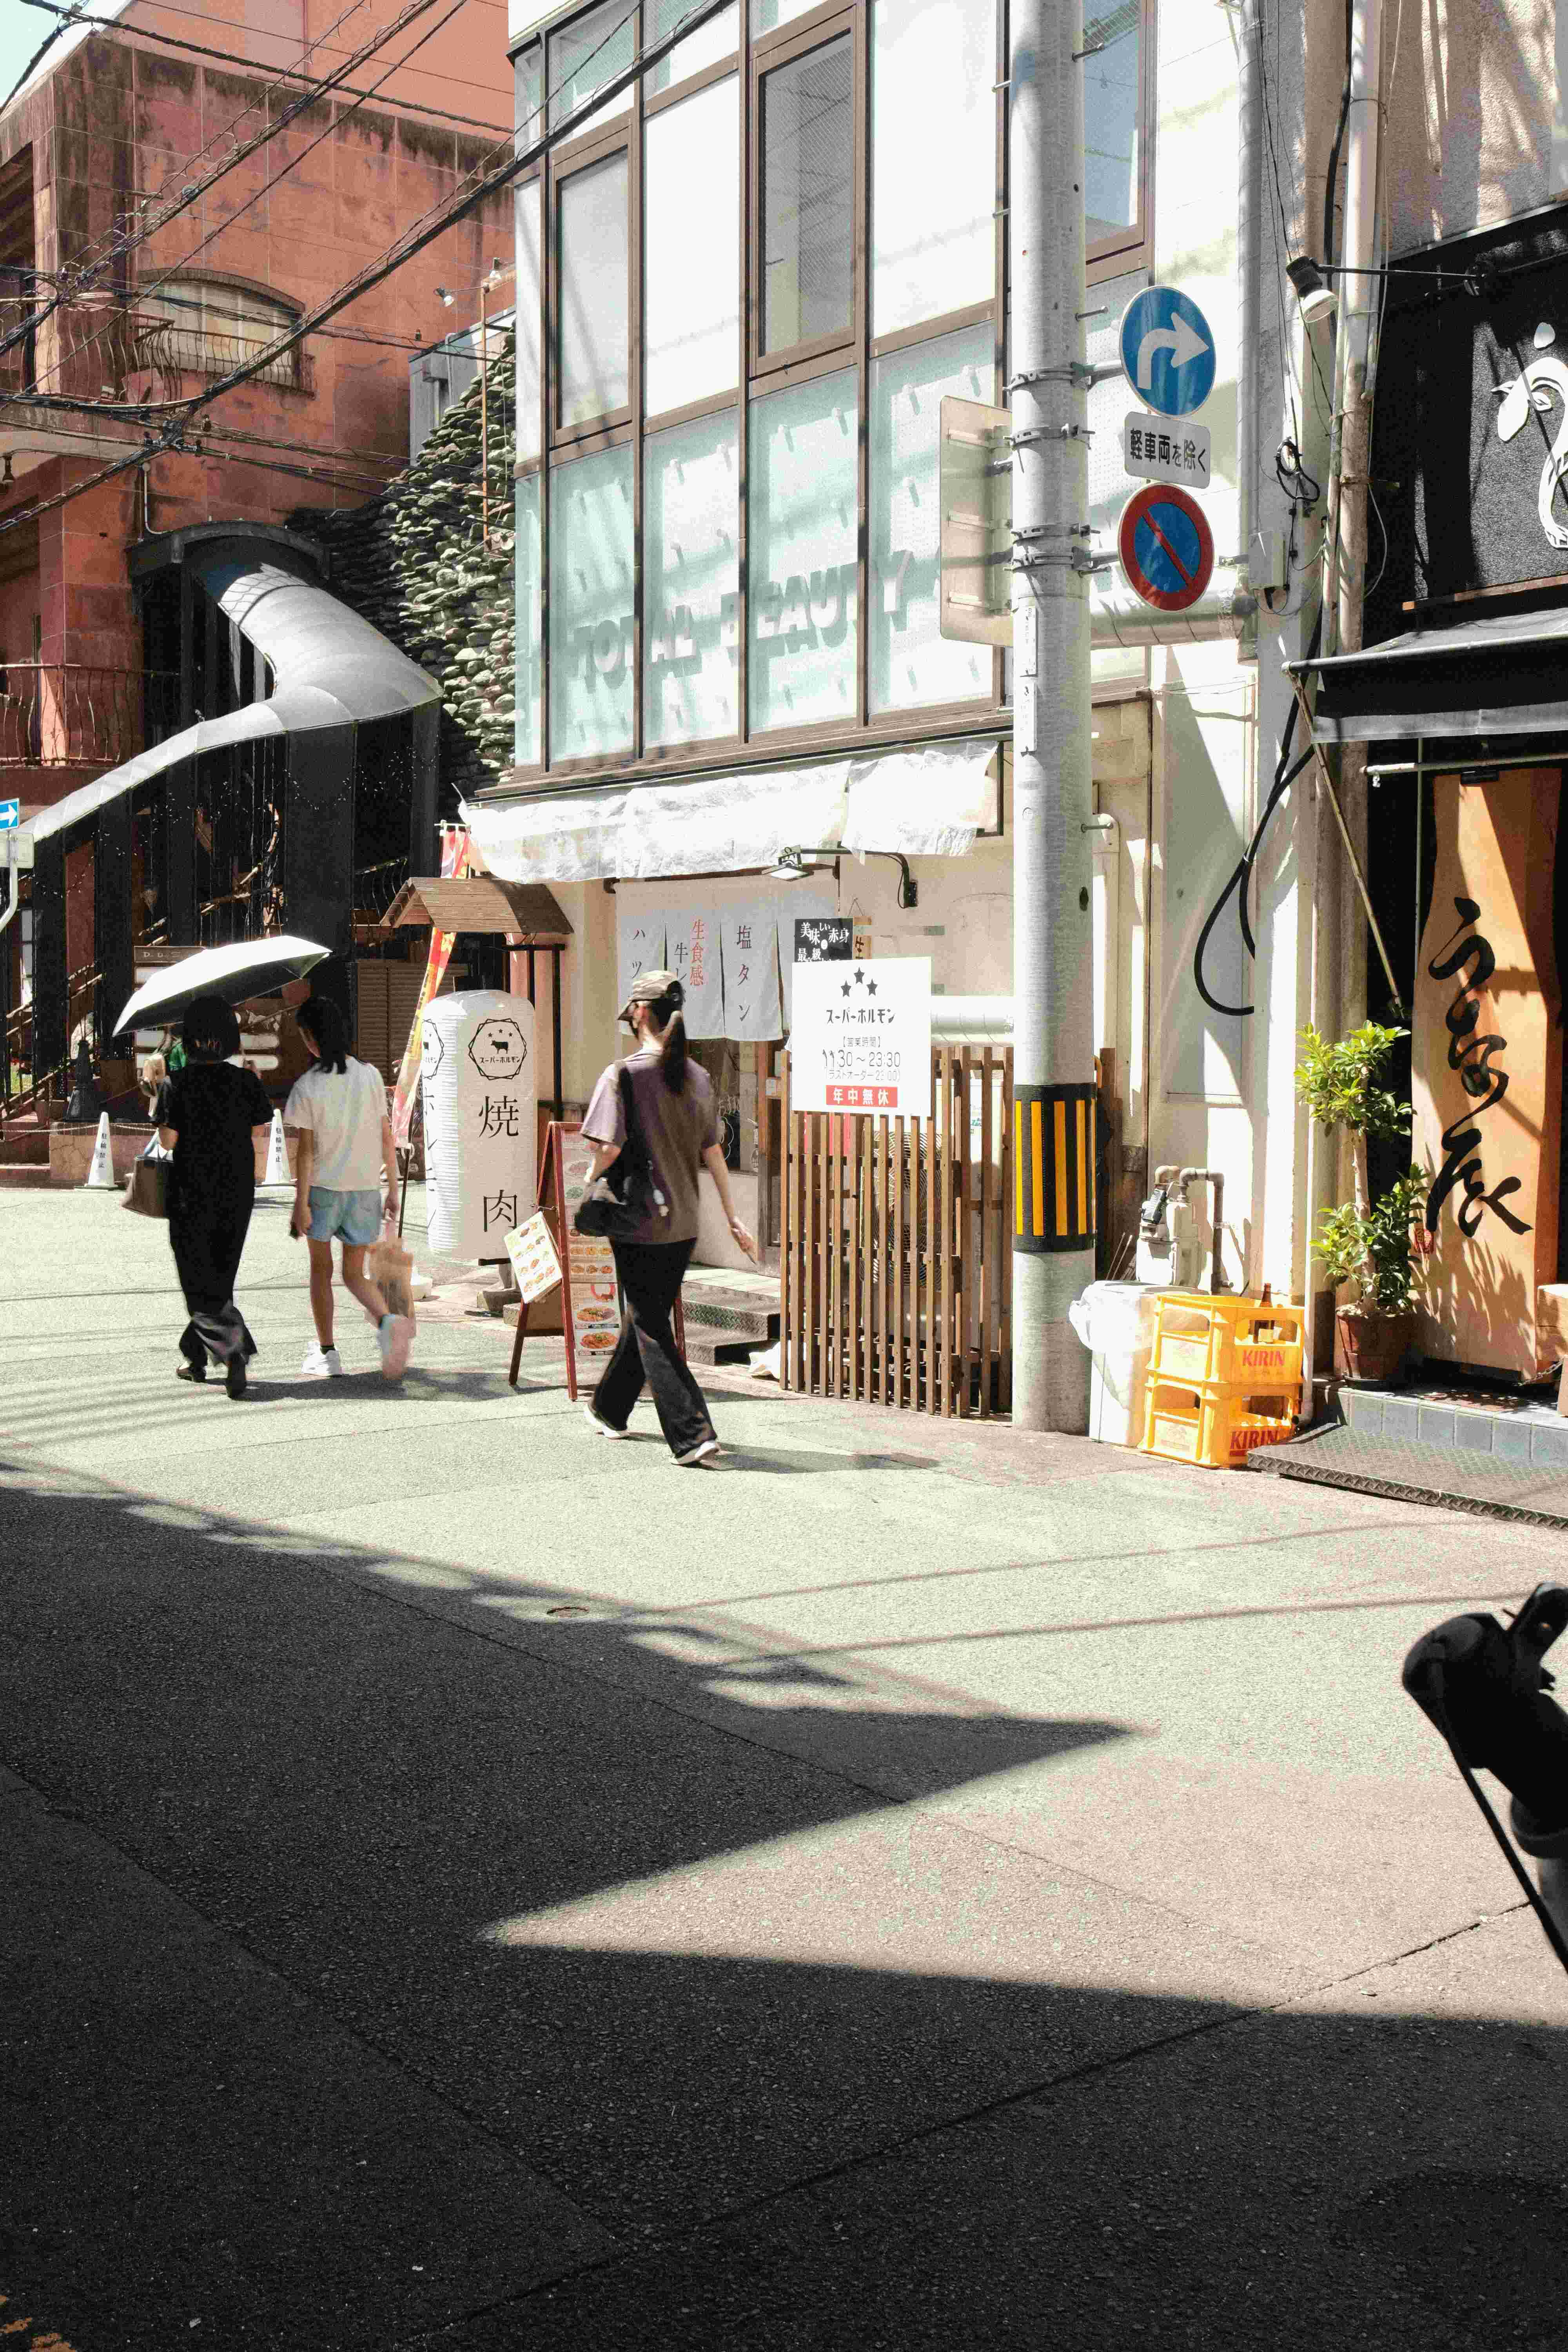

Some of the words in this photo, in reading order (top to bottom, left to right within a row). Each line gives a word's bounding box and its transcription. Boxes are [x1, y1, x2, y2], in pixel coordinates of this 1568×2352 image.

[1130, 428, 1206, 472] 軽車両を除く
[573, 605, 696, 677] TOTAL
[720, 550, 913, 647] BEAUTY
[690, 919, 704, 985] 生食感
[737, 925, 752, 1022] 塩タン
[826, 1007, 895, 1024] スーパーホルモン
[833, 1087, 889, 1106] 年中無休
[479, 1095, 519, 1232] 焼肉
[1242, 1349, 1285, 1367] KIRIN
[1230, 1430, 1279, 1450] KIRIN
